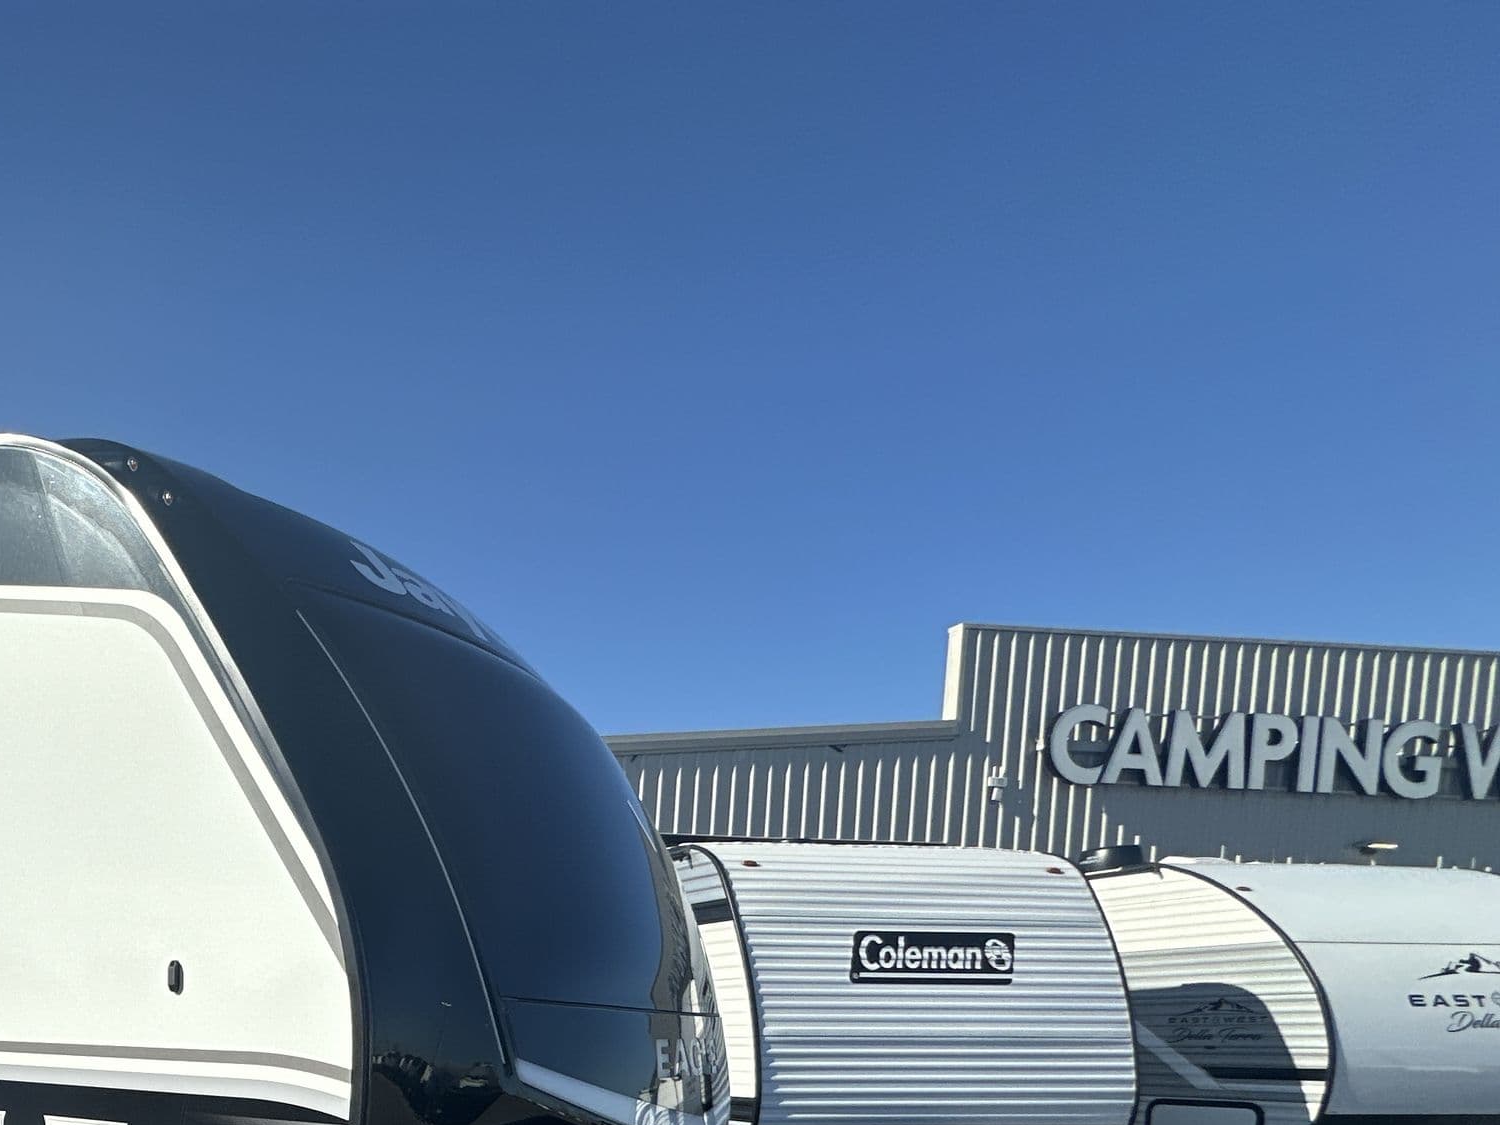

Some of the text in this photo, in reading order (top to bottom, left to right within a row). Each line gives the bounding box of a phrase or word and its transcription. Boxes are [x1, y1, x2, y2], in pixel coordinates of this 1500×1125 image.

[1049, 703, 1444, 799] CAMPING
[858, 934, 982, 971] Coleman
[1408, 994, 1486, 1007] EAST
